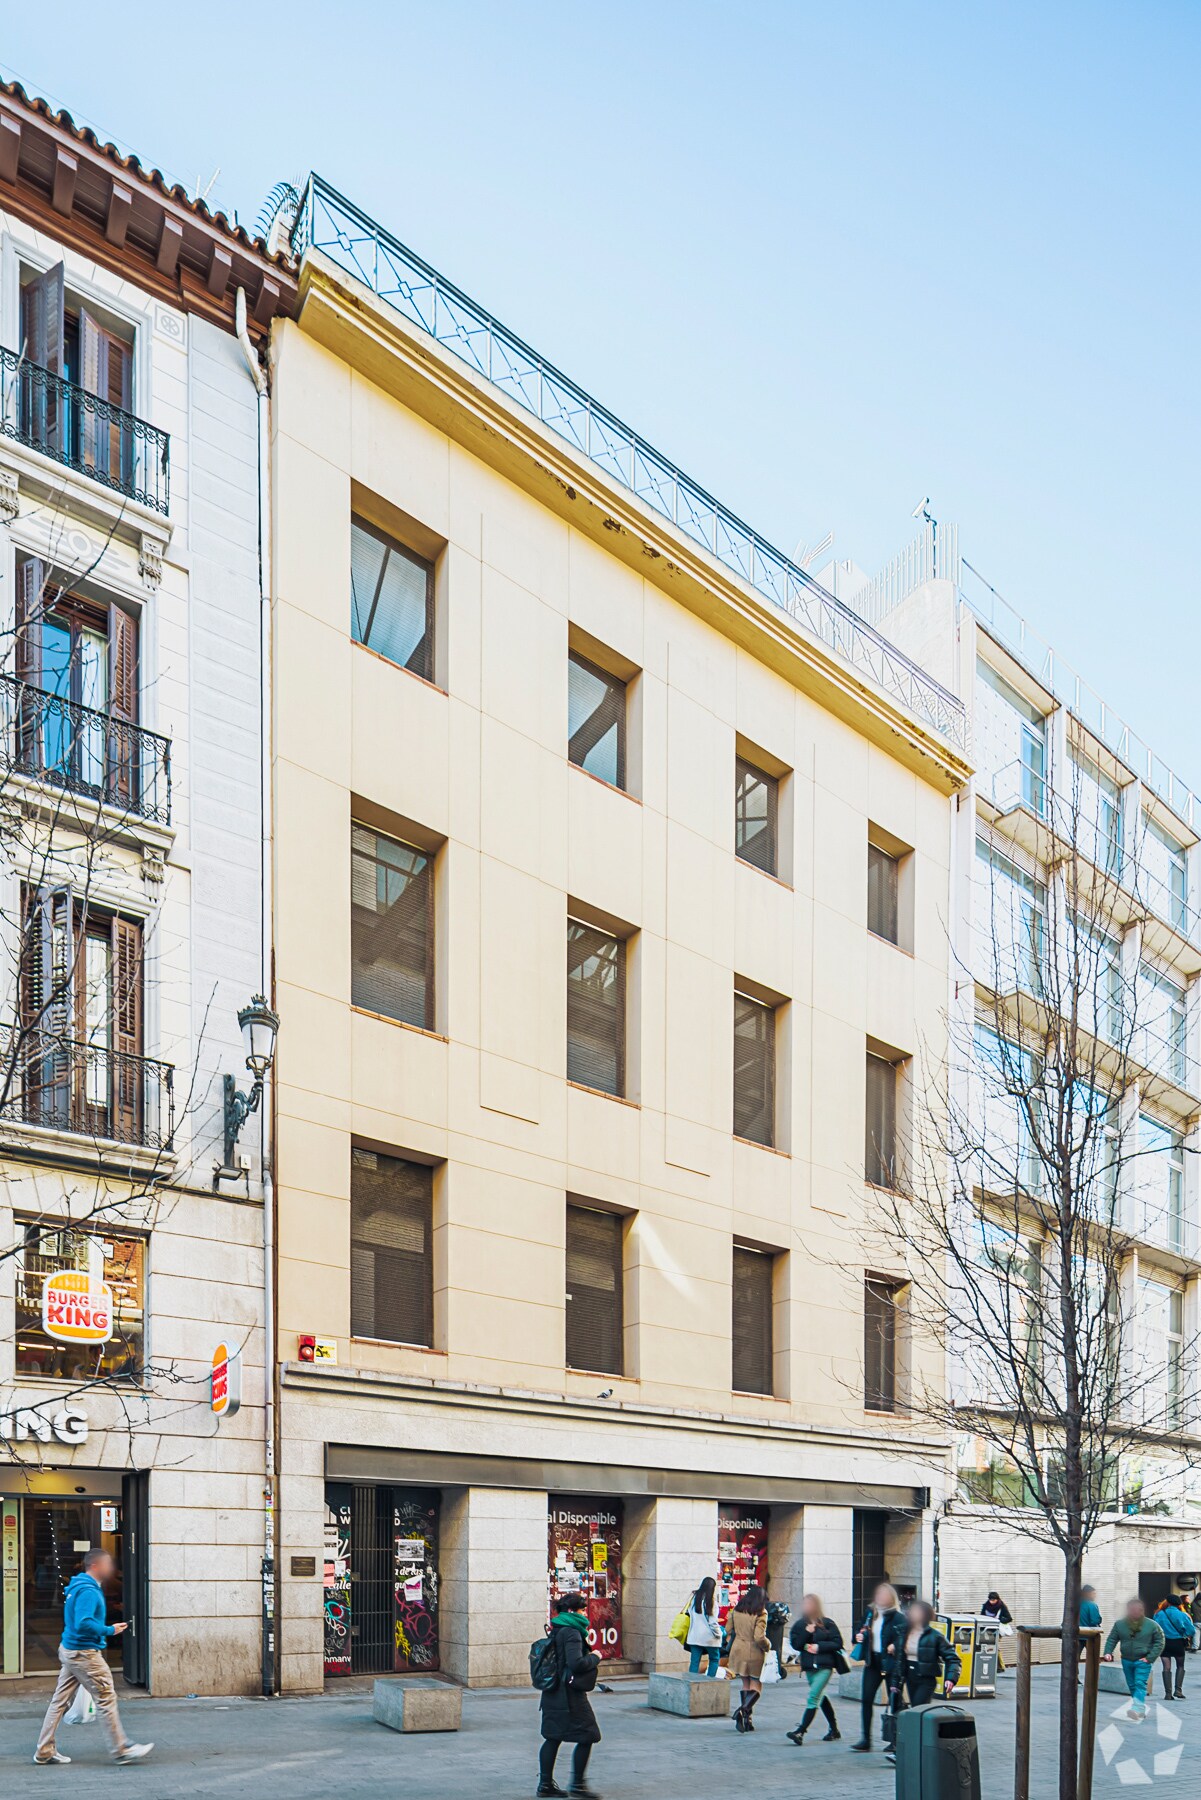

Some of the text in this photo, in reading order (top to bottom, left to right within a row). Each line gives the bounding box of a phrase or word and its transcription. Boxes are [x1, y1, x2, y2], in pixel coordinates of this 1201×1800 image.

[48, 1291, 108, 1310] BURGER
[48, 1304, 108, 1328] KING
[559, 1511, 617, 1527] Disponible
[600, 1627, 618, 1645] 10
